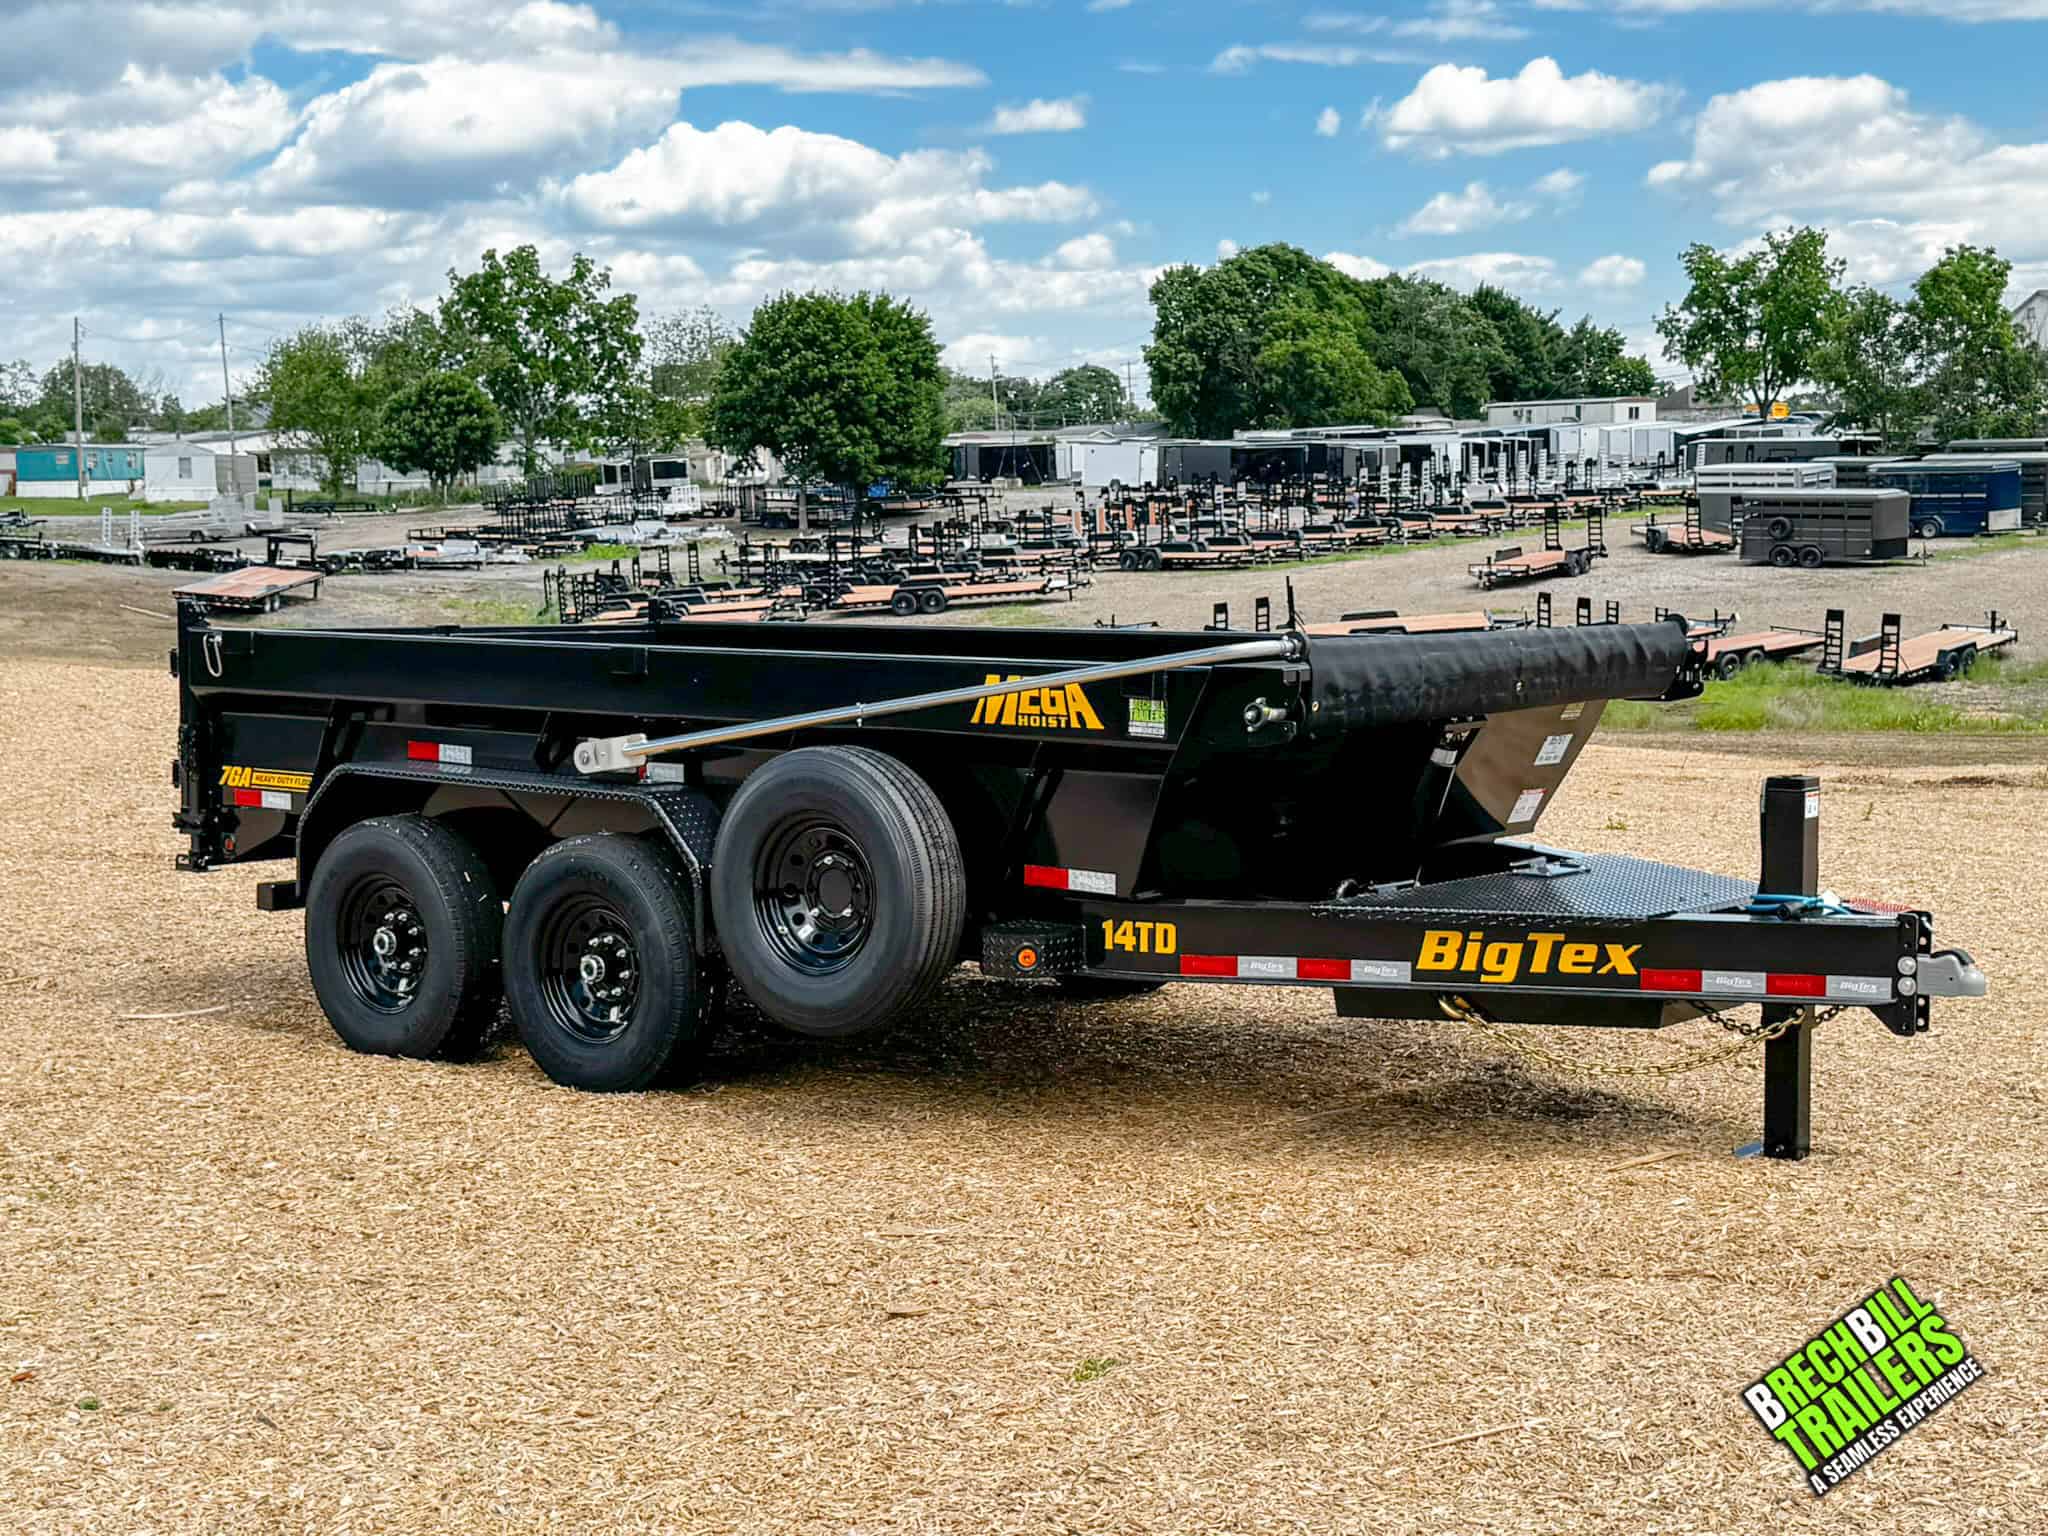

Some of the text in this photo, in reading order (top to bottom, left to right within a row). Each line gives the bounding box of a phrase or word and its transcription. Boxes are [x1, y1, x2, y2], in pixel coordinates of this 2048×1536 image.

[970, 674, 1105, 730] MEGA
[1018, 715, 1069, 729] HOIST
[1102, 919, 1177, 954] 14TD
[1416, 930, 1642, 983] BigTex
